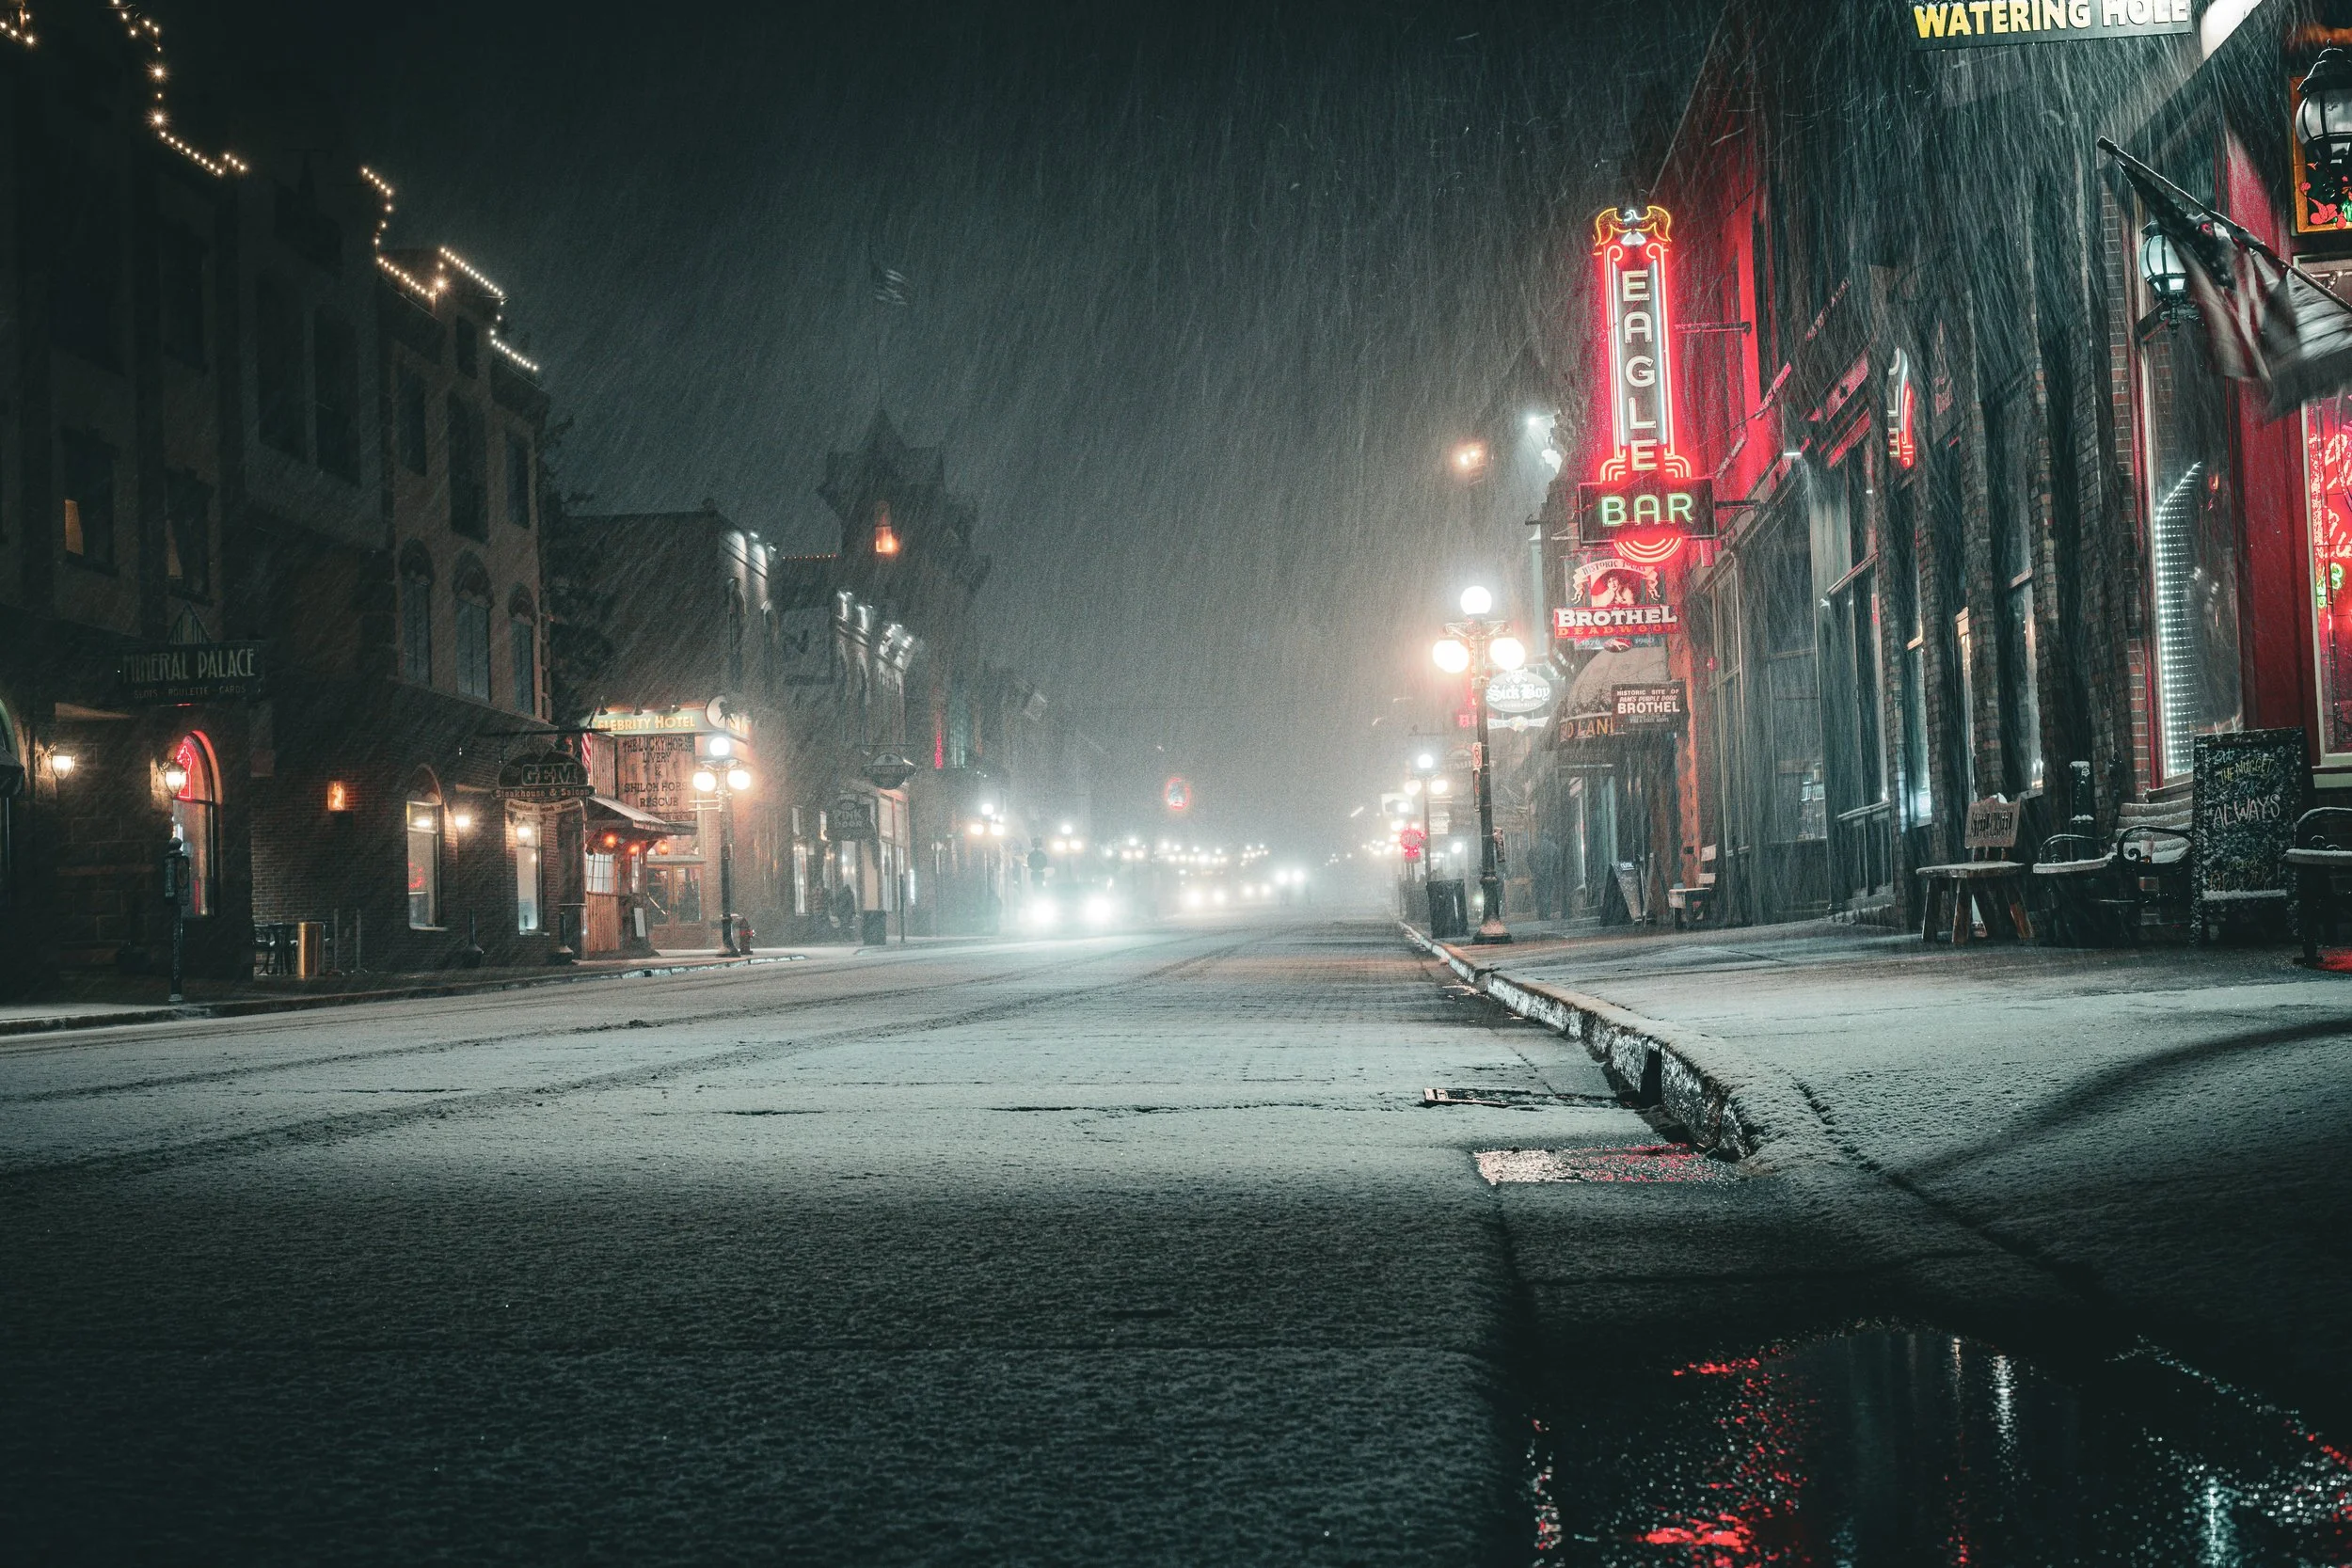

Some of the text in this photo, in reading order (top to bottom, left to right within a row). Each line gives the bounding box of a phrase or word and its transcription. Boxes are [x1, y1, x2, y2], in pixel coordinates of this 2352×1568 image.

[1914, 0, 2189, 39] WATERING HOLE
[1622, 269, 1659, 471] EAGLE
[1601, 493, 1693, 527] BAR
[1581, 560, 1617, 576] HISTORIC
[1557, 604, 1677, 627] BROTHEL
[1558, 625, 1676, 636] DEADWOOD
[123, 648, 255, 684] MINERAL PALACE
[167, 687, 209, 696] ROULETTE
[1617, 702, 1680, 714] BROTHEL
[654, 715, 695, 729] HOTEL
[639, 736, 665, 752] LUCKY
[643, 752, 672, 763] LIVERY
[521, 763, 578, 785] GEM
[496, 789, 546, 798] Steakhouse
[640, 797, 678, 808] RESCUE
[2213, 794, 2280, 830] ALWAYS
